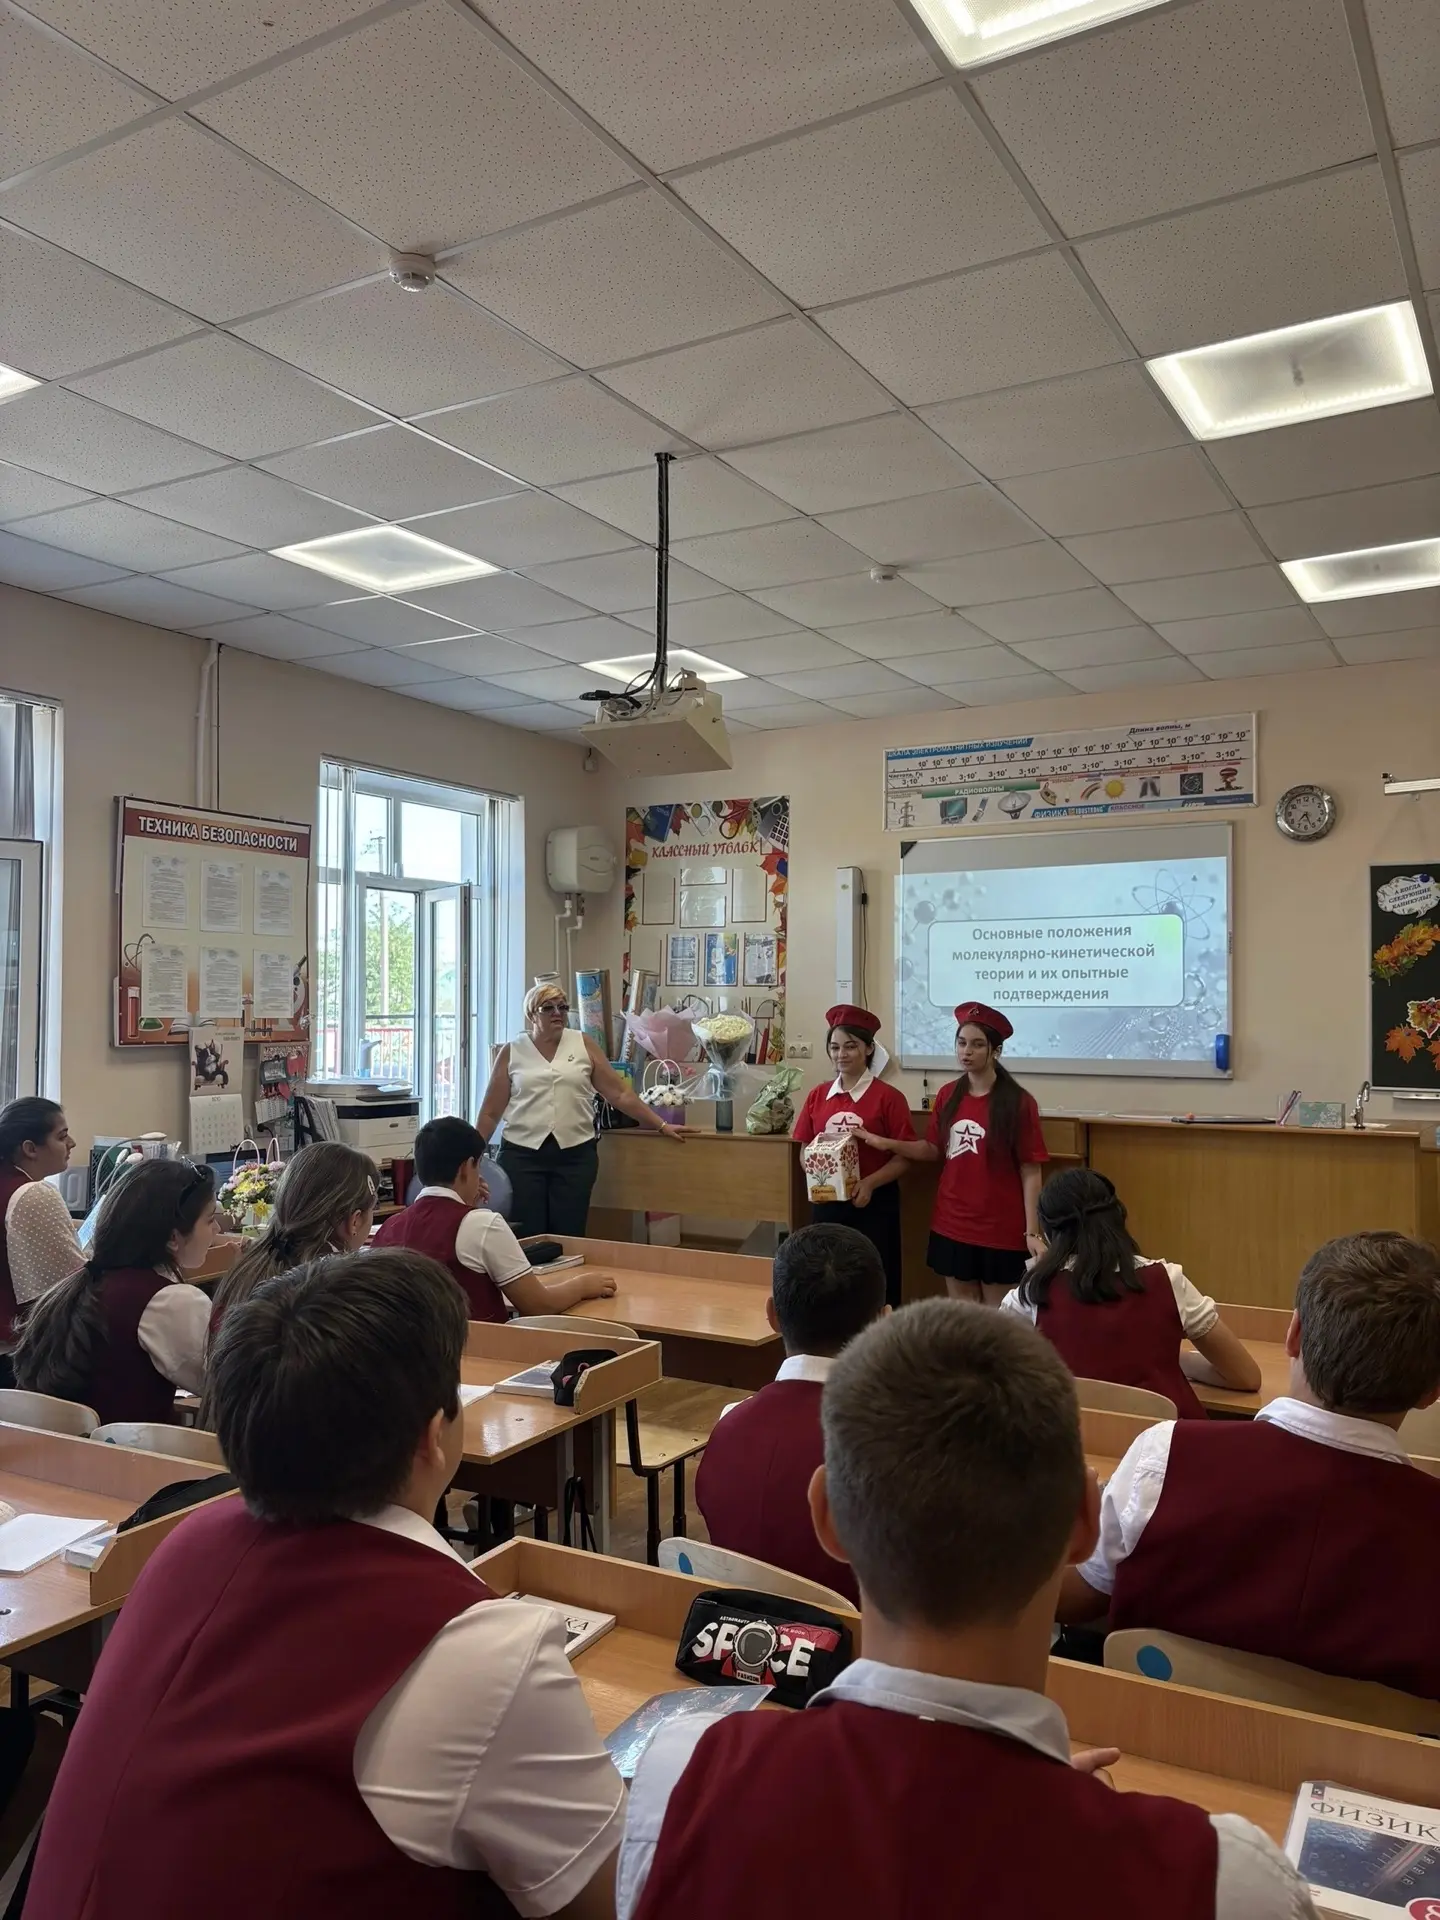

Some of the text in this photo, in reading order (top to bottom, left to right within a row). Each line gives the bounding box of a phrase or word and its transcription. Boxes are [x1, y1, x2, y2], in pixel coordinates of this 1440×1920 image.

[954, 786, 1005, 795] РАДИОВОЛНЫ
[1034, 808, 1068, 818] ФИЗИКА
[138, 815, 298, 852] ТЕХНИКА БЕЗОПАСНОСТИ
[652, 841, 759, 858] КЛАССНЫЙ УГОЛОК
[972, 926, 1132, 940] Основные положения
[952, 943, 1155, 963] молекулярно-кинетической
[975, 968, 1129, 982] теории и их опытные
[993, 989, 1109, 1002] подтверждения
[691, 1621, 817, 1677] SPCE
[737, 1671, 761, 1683] FASHION
